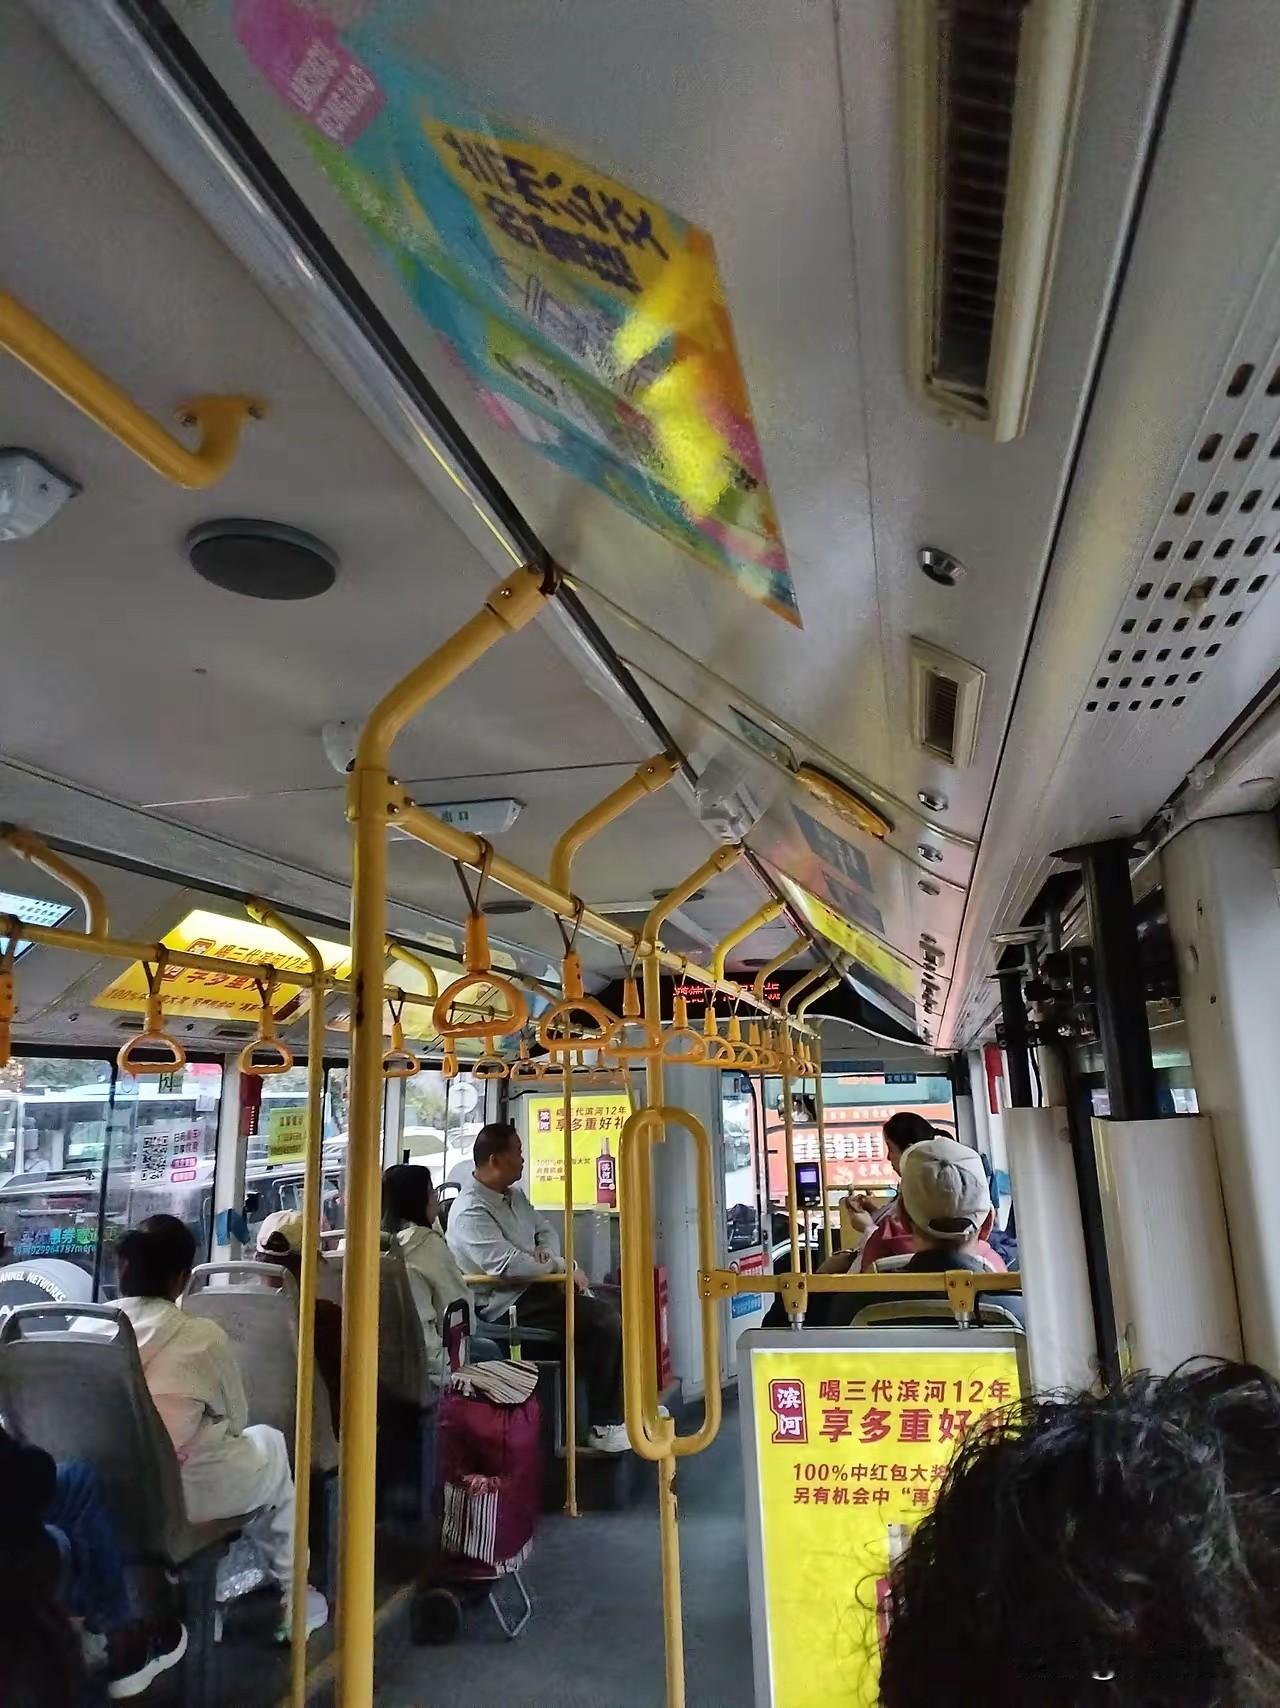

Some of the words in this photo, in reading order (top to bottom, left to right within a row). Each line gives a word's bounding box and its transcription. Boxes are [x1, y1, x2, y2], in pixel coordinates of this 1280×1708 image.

[0, 1271, 25, 1283] ANNEL
[26, 1271, 67, 1302] NETWORKS
[819, 1379, 1011, 1403] 喝三代滨河12年
[776, 1386, 804, 1436] 滨河
